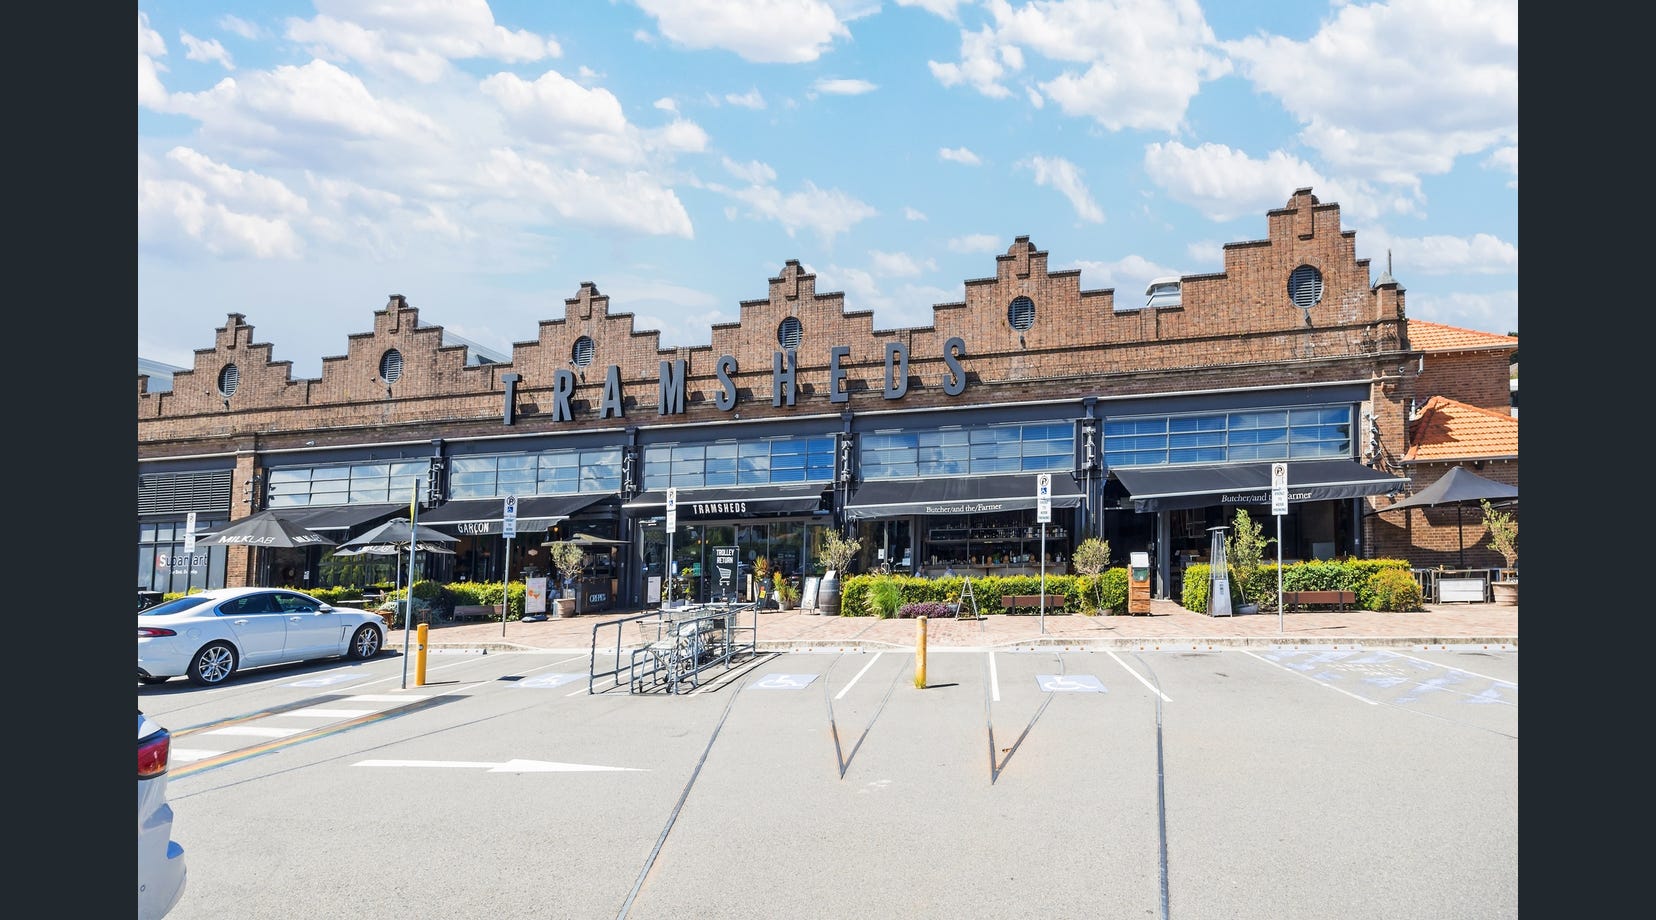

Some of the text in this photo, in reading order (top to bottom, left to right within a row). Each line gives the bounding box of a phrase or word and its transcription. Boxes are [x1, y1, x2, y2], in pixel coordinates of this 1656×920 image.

[502, 337, 966, 425] TRAMSHEDS
[692, 502, 747, 515] TRAMSHEDS
[457, 522, 490, 536] GARÇON
[218, 535, 276, 544] MILKLAB
